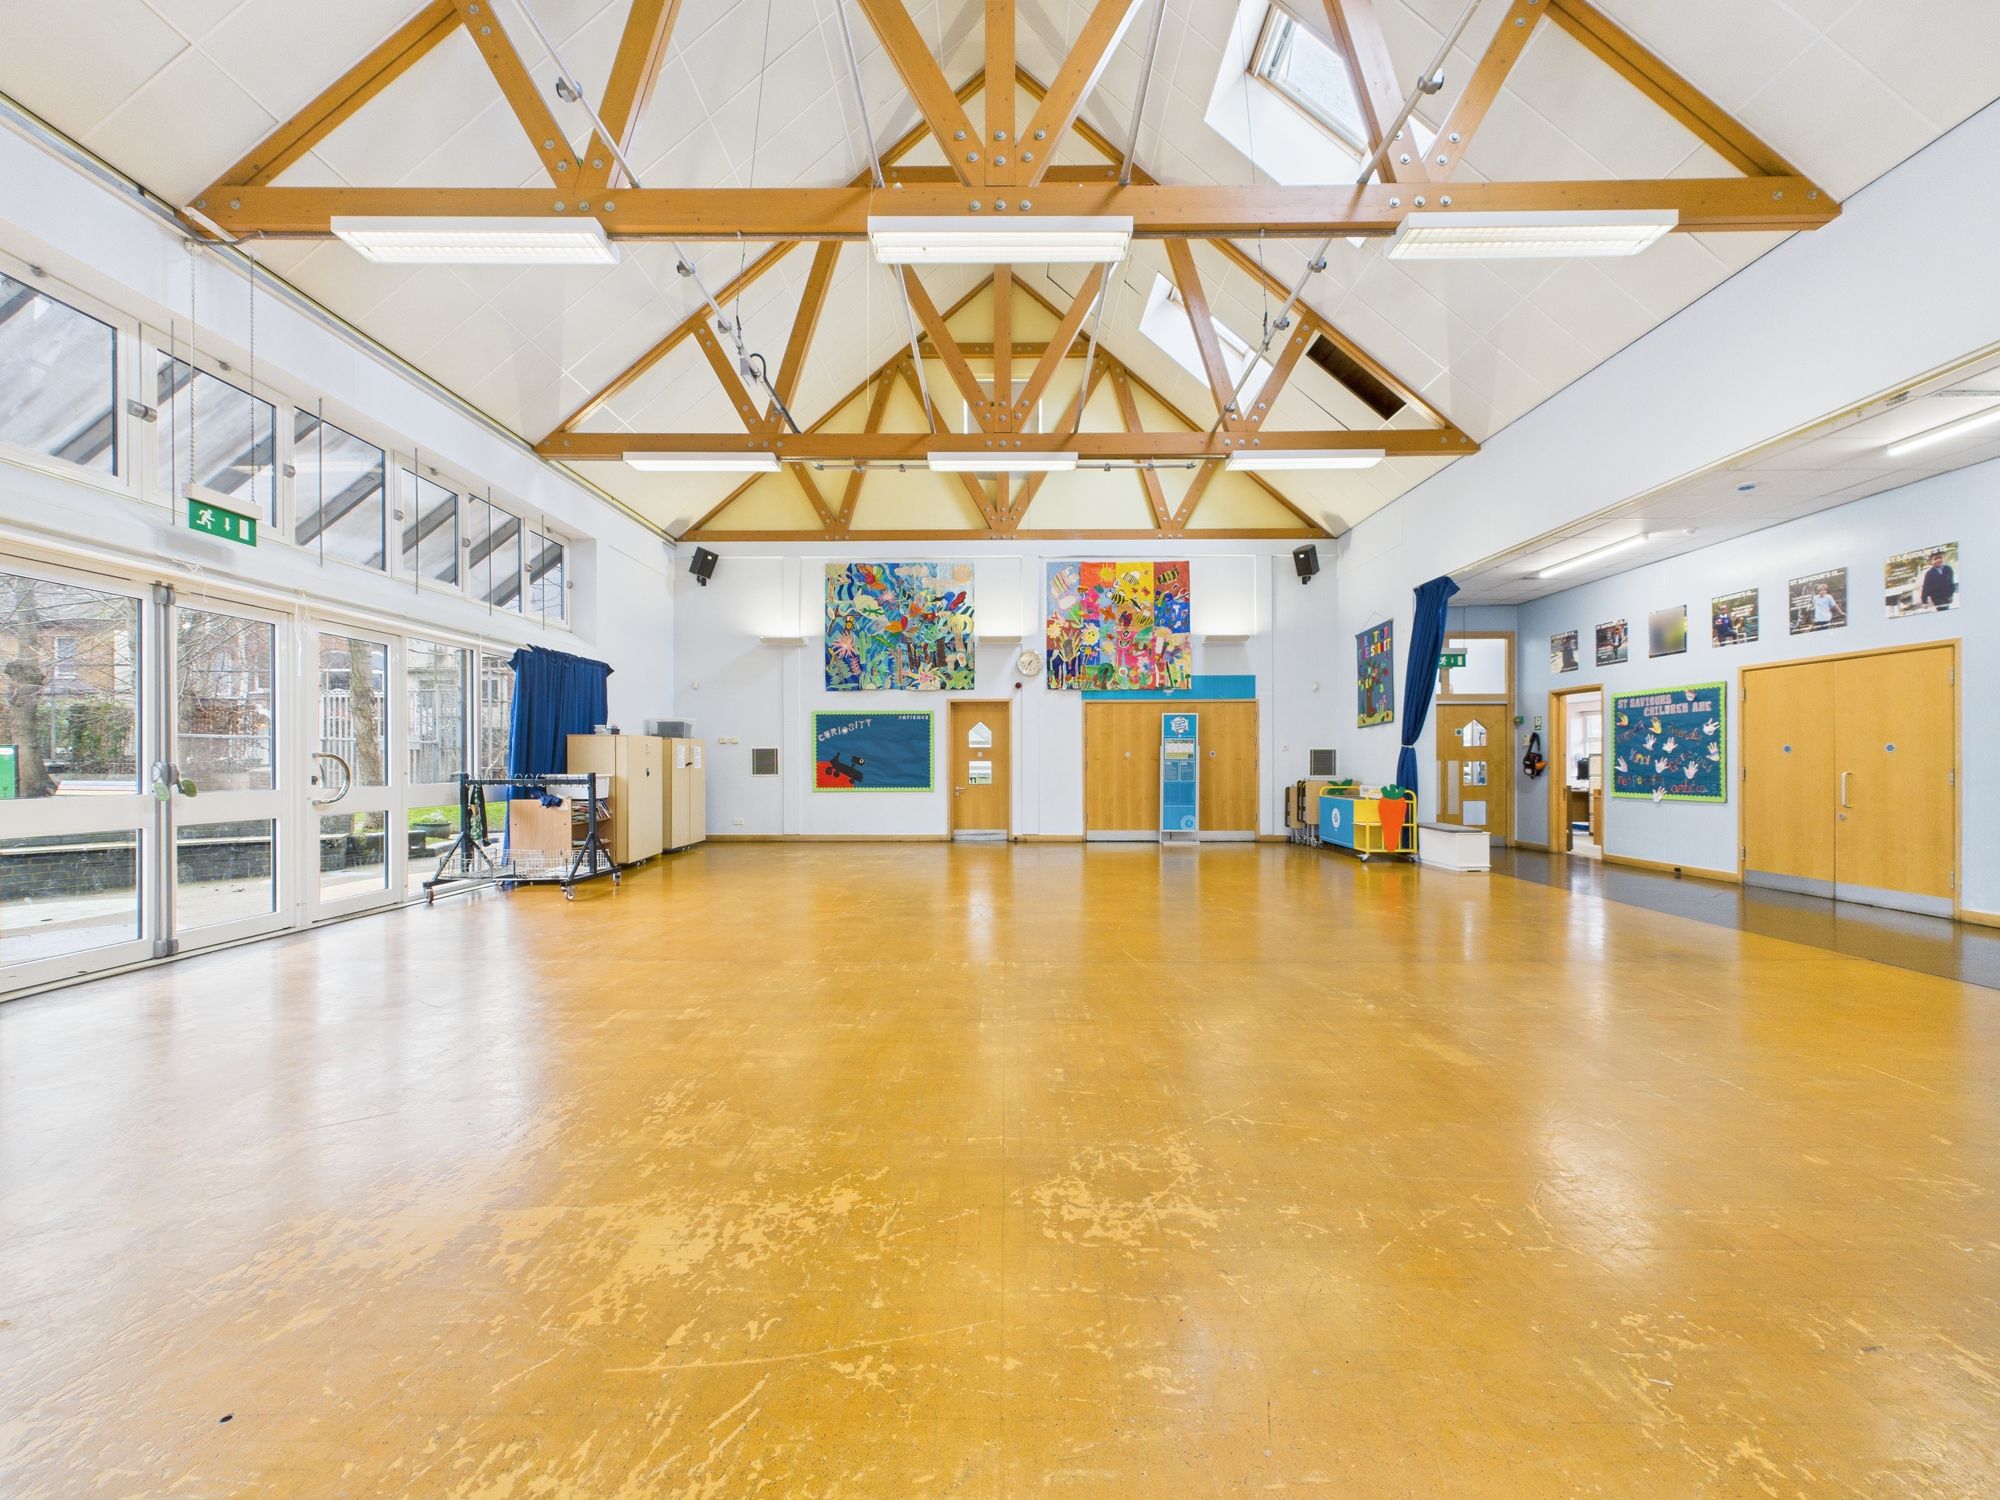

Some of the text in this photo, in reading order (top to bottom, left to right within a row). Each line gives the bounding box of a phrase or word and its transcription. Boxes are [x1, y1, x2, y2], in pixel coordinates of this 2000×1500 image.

[1618, 694, 1672, 709] ST SAVIOURS
[1644, 701, 1712, 716] CHILDREN ARE
[817, 719, 872, 742] CURIOSITY
